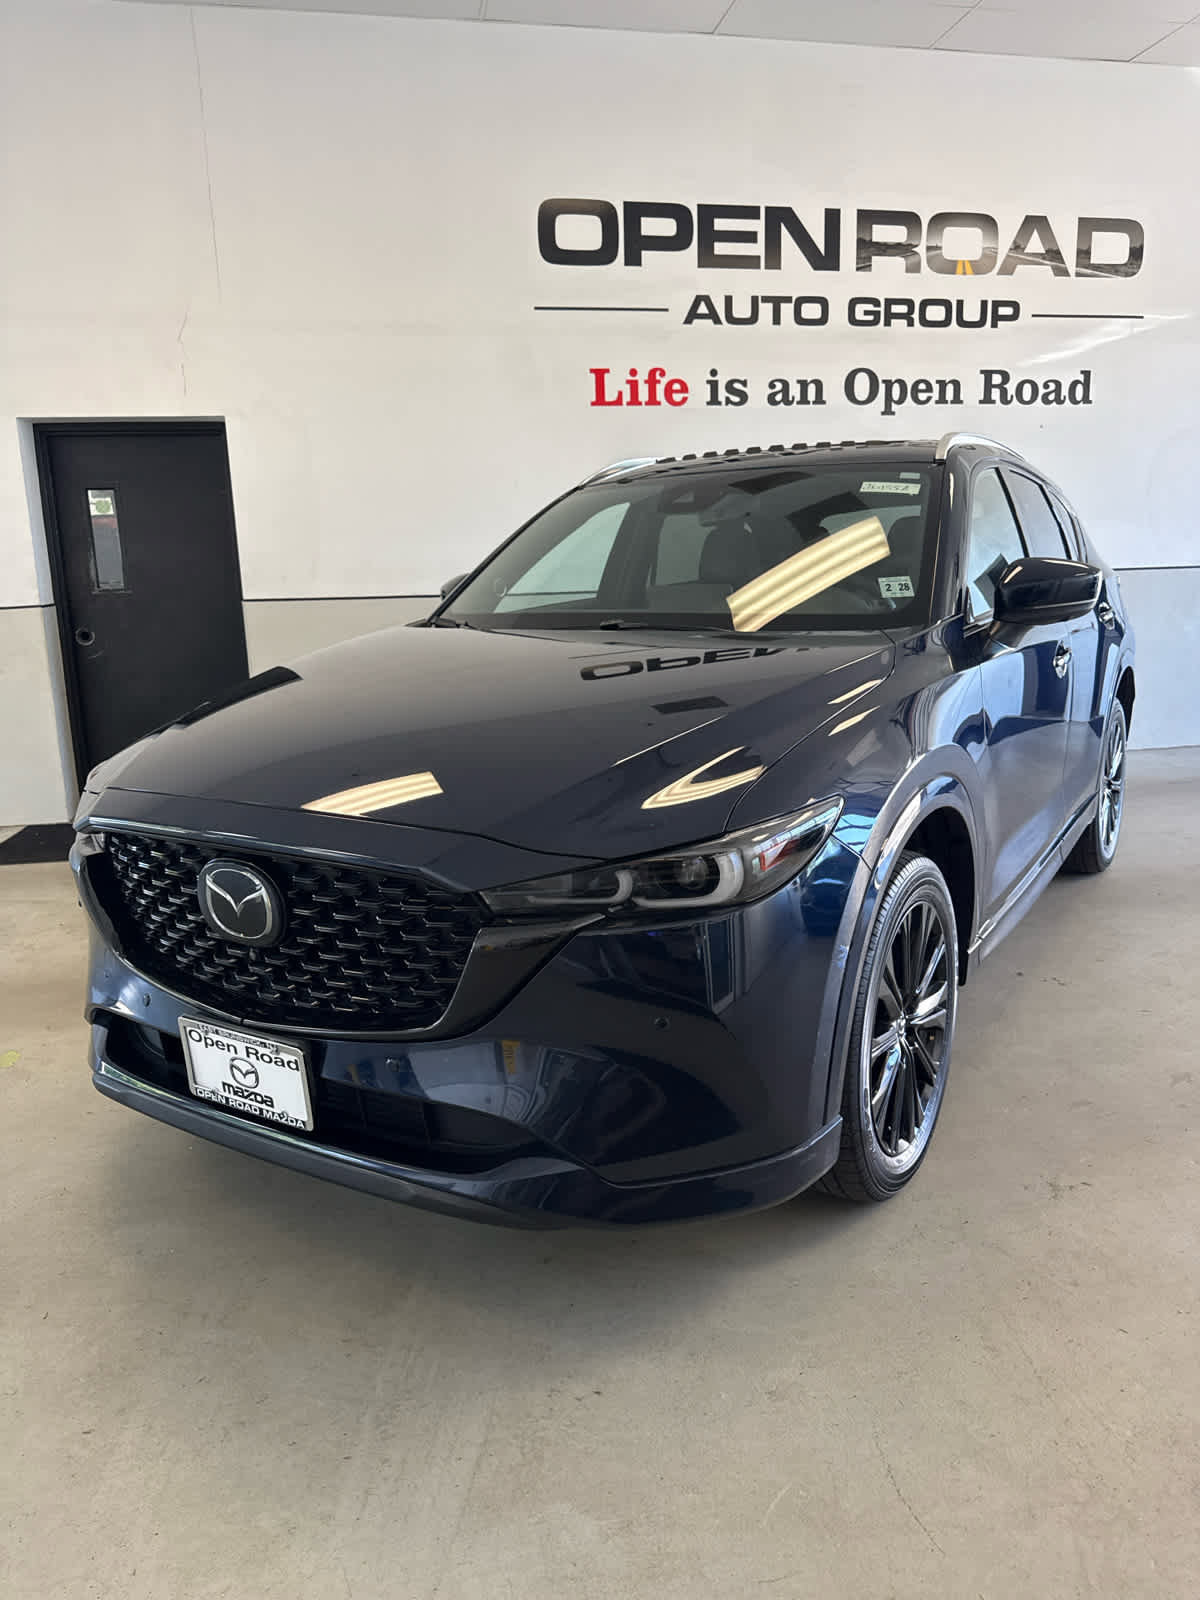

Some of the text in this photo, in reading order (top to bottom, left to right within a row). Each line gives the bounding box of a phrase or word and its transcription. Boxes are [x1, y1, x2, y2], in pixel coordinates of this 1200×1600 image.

[537, 198, 1144, 278] OPEN ROAD
[682, 294, 1020, 328] AUTO GROUP
[589, 367, 1093, 416] Life is an Open Road
[188, 1028, 238, 1055] Open
[245, 1045, 300, 1072] Road
[196, 1088, 305, 1129] OPEN ROAD MAZDA
[221, 1081, 275, 1109] mazda
